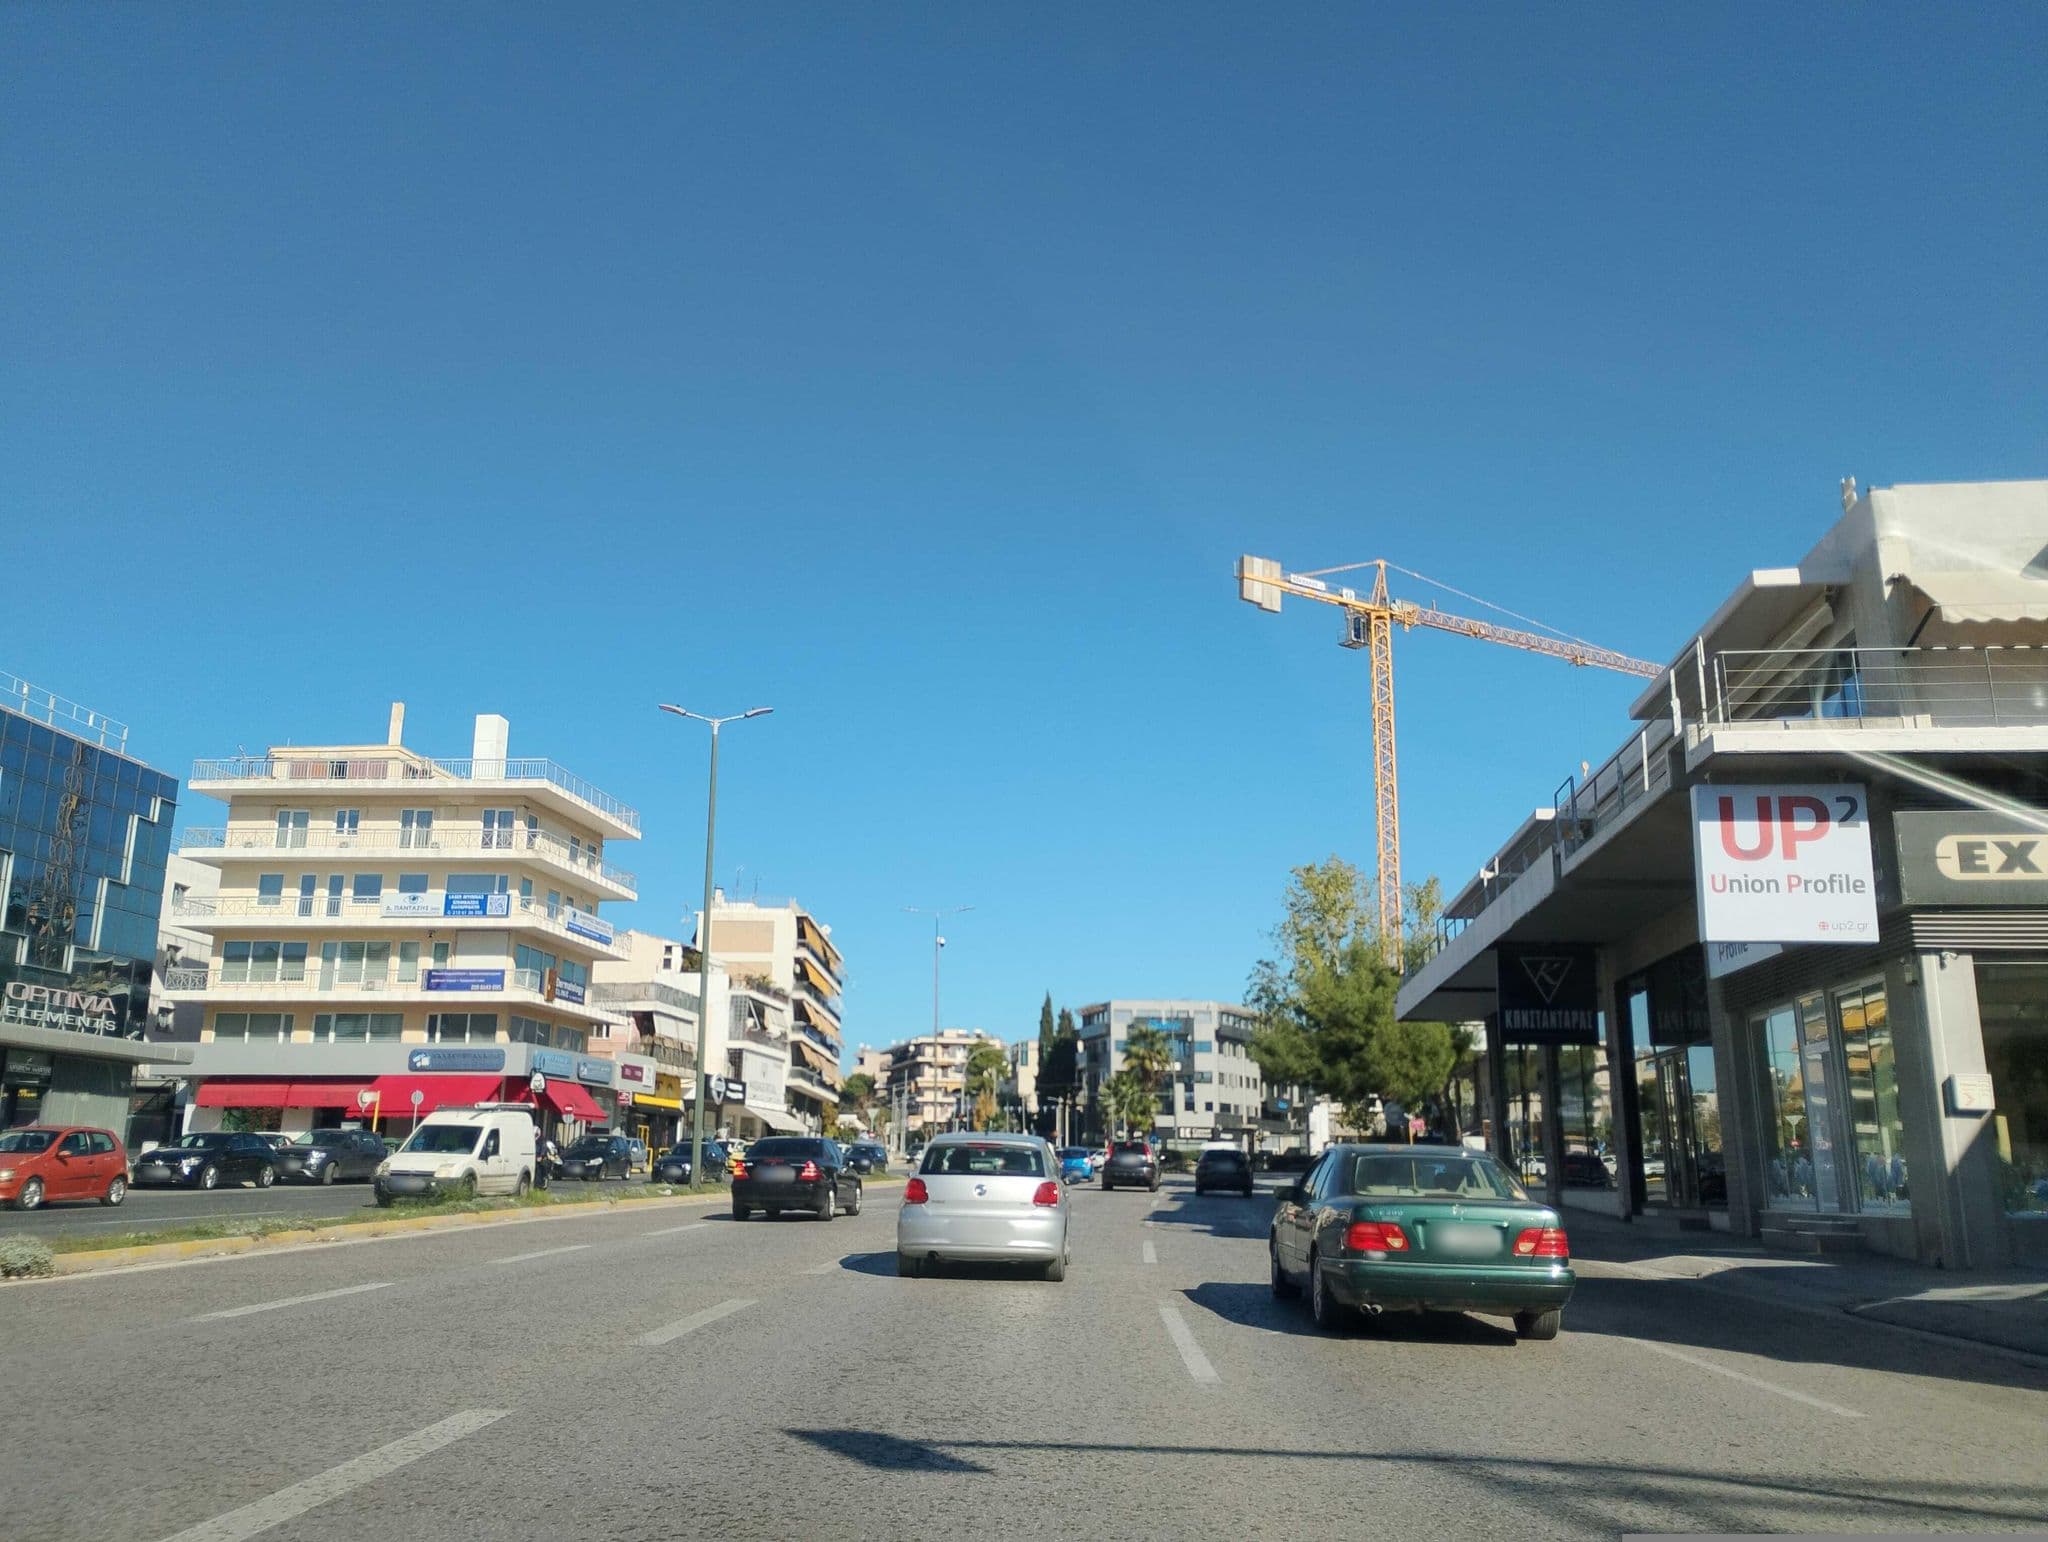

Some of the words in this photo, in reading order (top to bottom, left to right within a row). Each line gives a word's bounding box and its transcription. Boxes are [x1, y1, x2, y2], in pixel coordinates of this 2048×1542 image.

[1957, 841, 2044, 873] EX
[1711, 873, 1780, 894] Union
[1786, 873, 1866, 894] Profile
[1831, 921, 1870, 933] up2.gr
[5, 981, 117, 1015] OPTIMA
[5, 1003, 117, 1031] ELEMENTS
